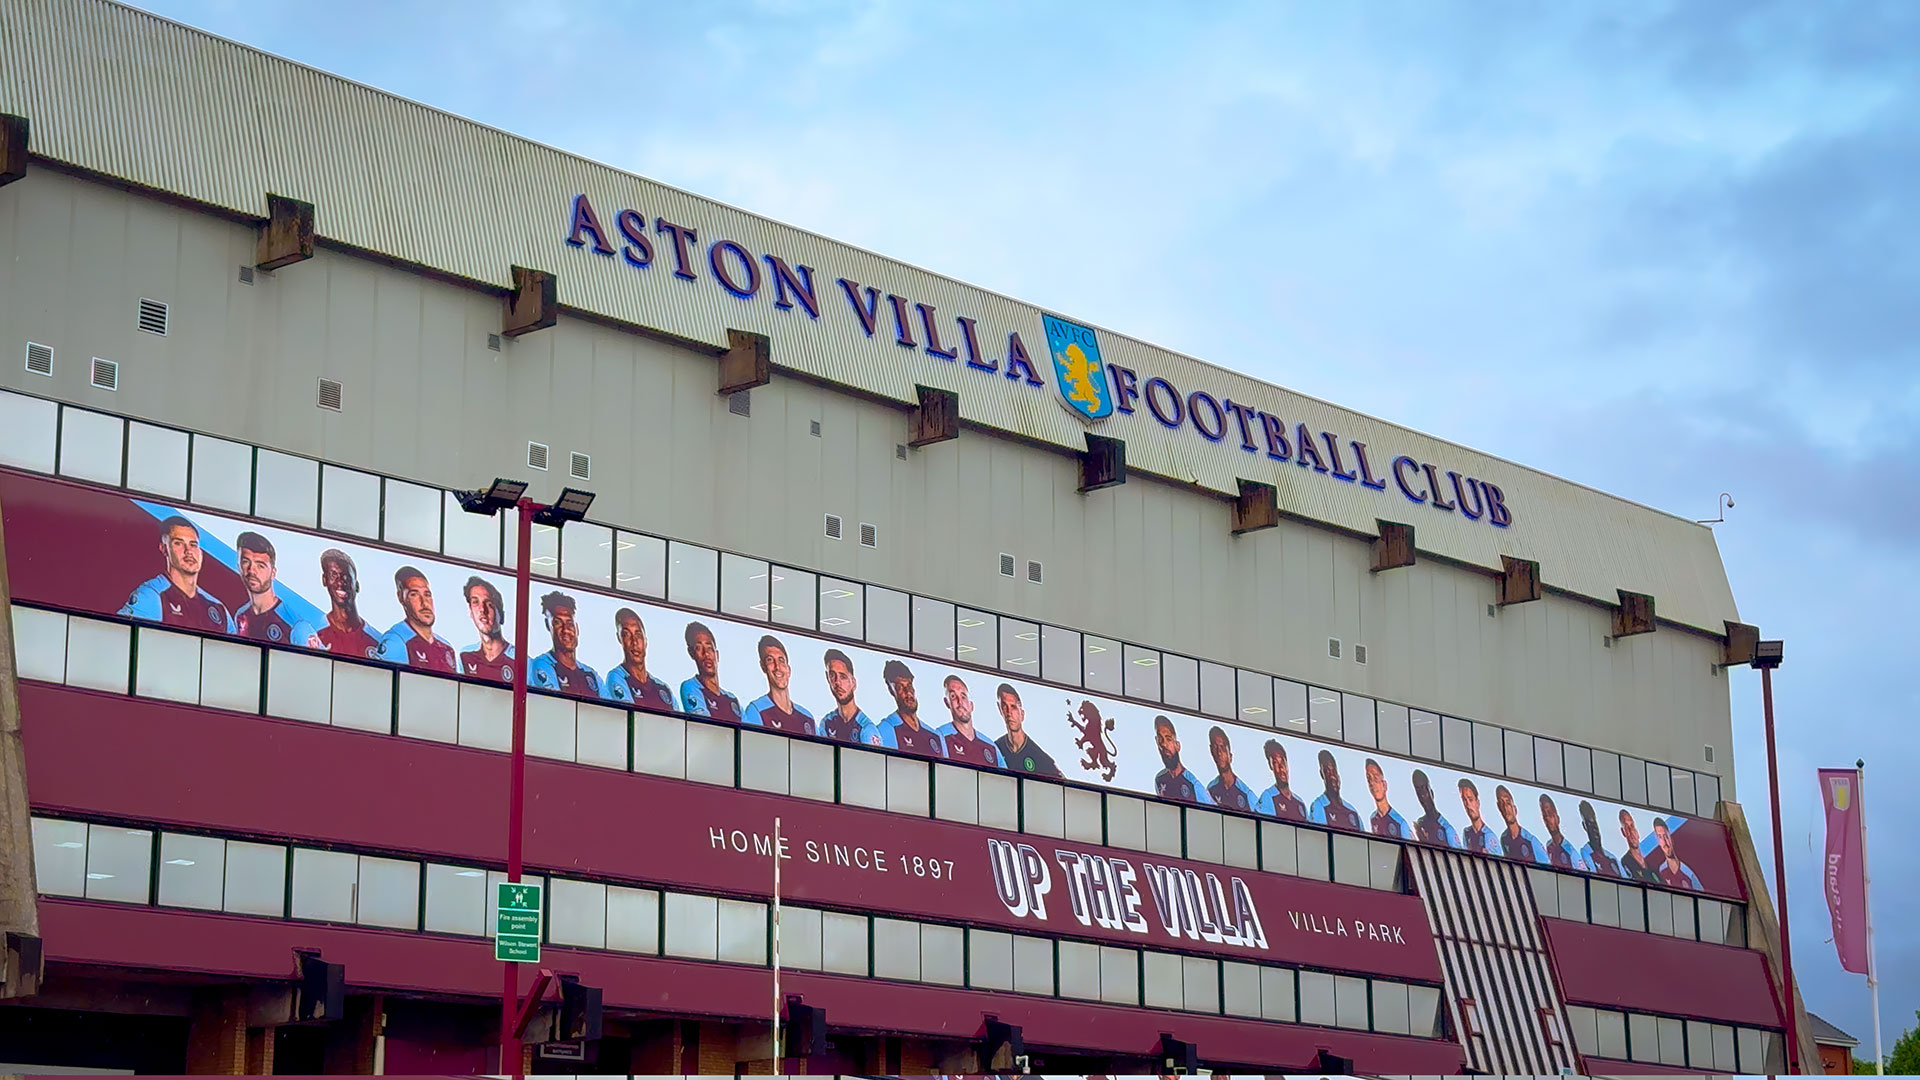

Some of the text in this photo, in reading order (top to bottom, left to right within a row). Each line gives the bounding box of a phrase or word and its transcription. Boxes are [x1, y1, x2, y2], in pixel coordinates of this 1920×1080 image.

[565, 193, 1045, 387] ASTON VILLA
[1050, 321, 1095, 348] AVFC
[1107, 363, 1513, 527] FOOTBALL CLUB
[709, 826, 955, 881] HOME SINCE 1897
[499, 913, 538, 923] Fire assembly
[987, 838, 1269, 949] UP THE VILLA
[1288, 910, 1407, 946] VILLA PARK
